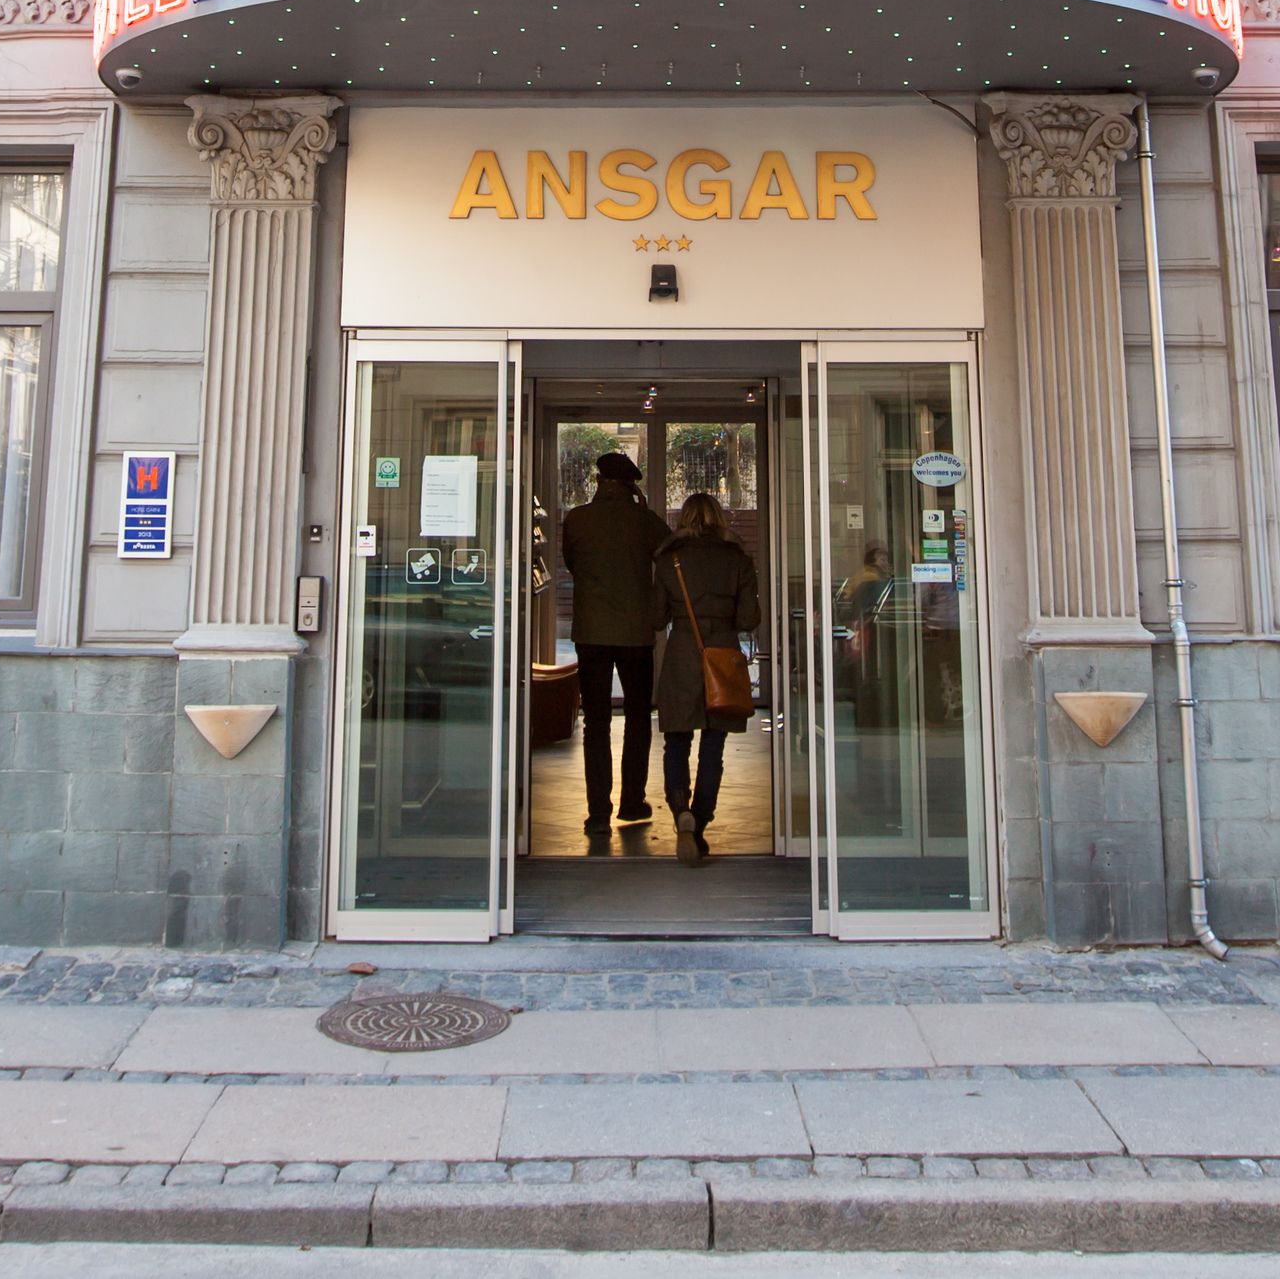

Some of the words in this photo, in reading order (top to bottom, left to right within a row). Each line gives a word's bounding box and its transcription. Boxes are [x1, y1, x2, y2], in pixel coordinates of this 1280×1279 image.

[448, 148, 878, 221] ANSGAR
[915, 453, 961, 468] Copenhagen
[137, 466, 158, 491] H
[916, 468, 949, 476] welcomes
